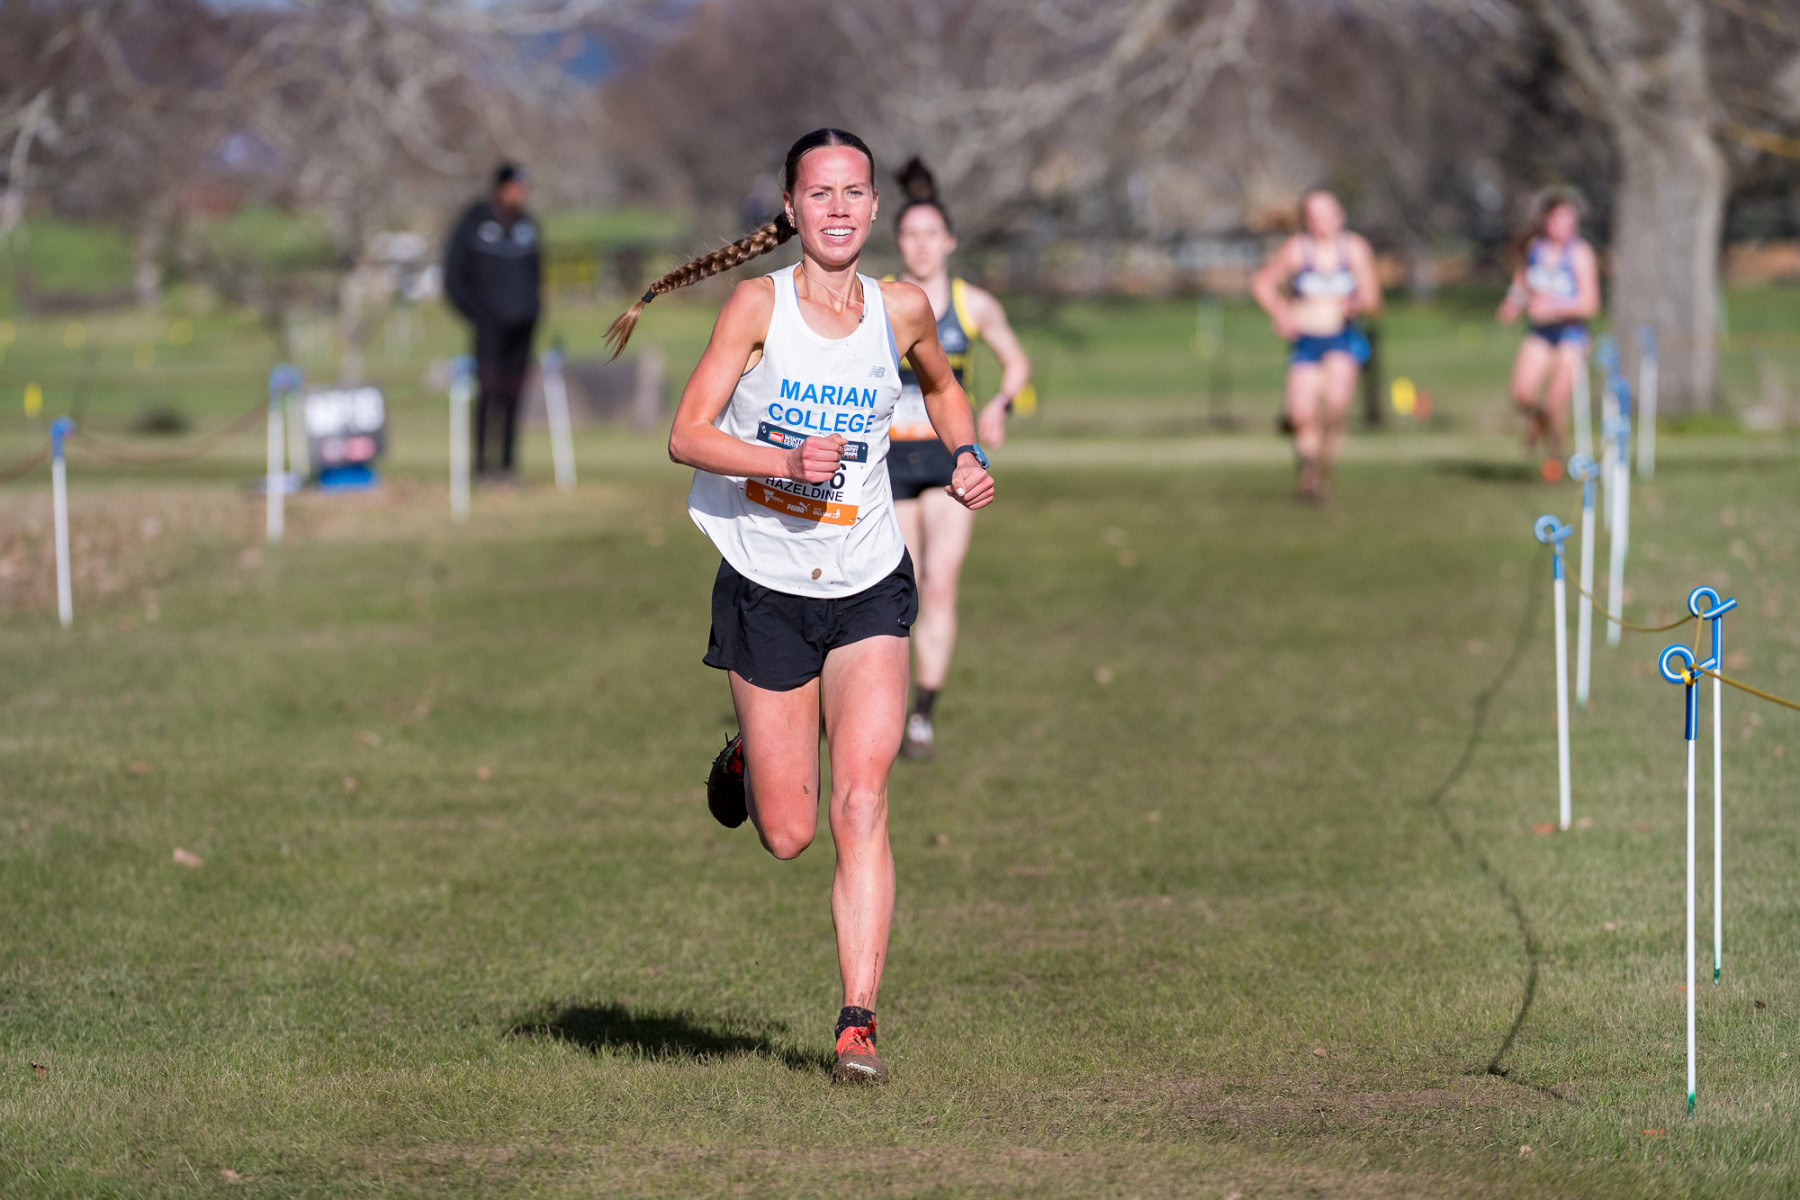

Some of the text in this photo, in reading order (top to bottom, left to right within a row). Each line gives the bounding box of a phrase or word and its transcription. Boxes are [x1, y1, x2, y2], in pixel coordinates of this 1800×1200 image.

[780, 379, 877, 408] MARIAN
[768, 403, 876, 433] COLLEGE
[784, 433, 805, 445] WINT
[765, 477, 844, 502] HAZELDINE
